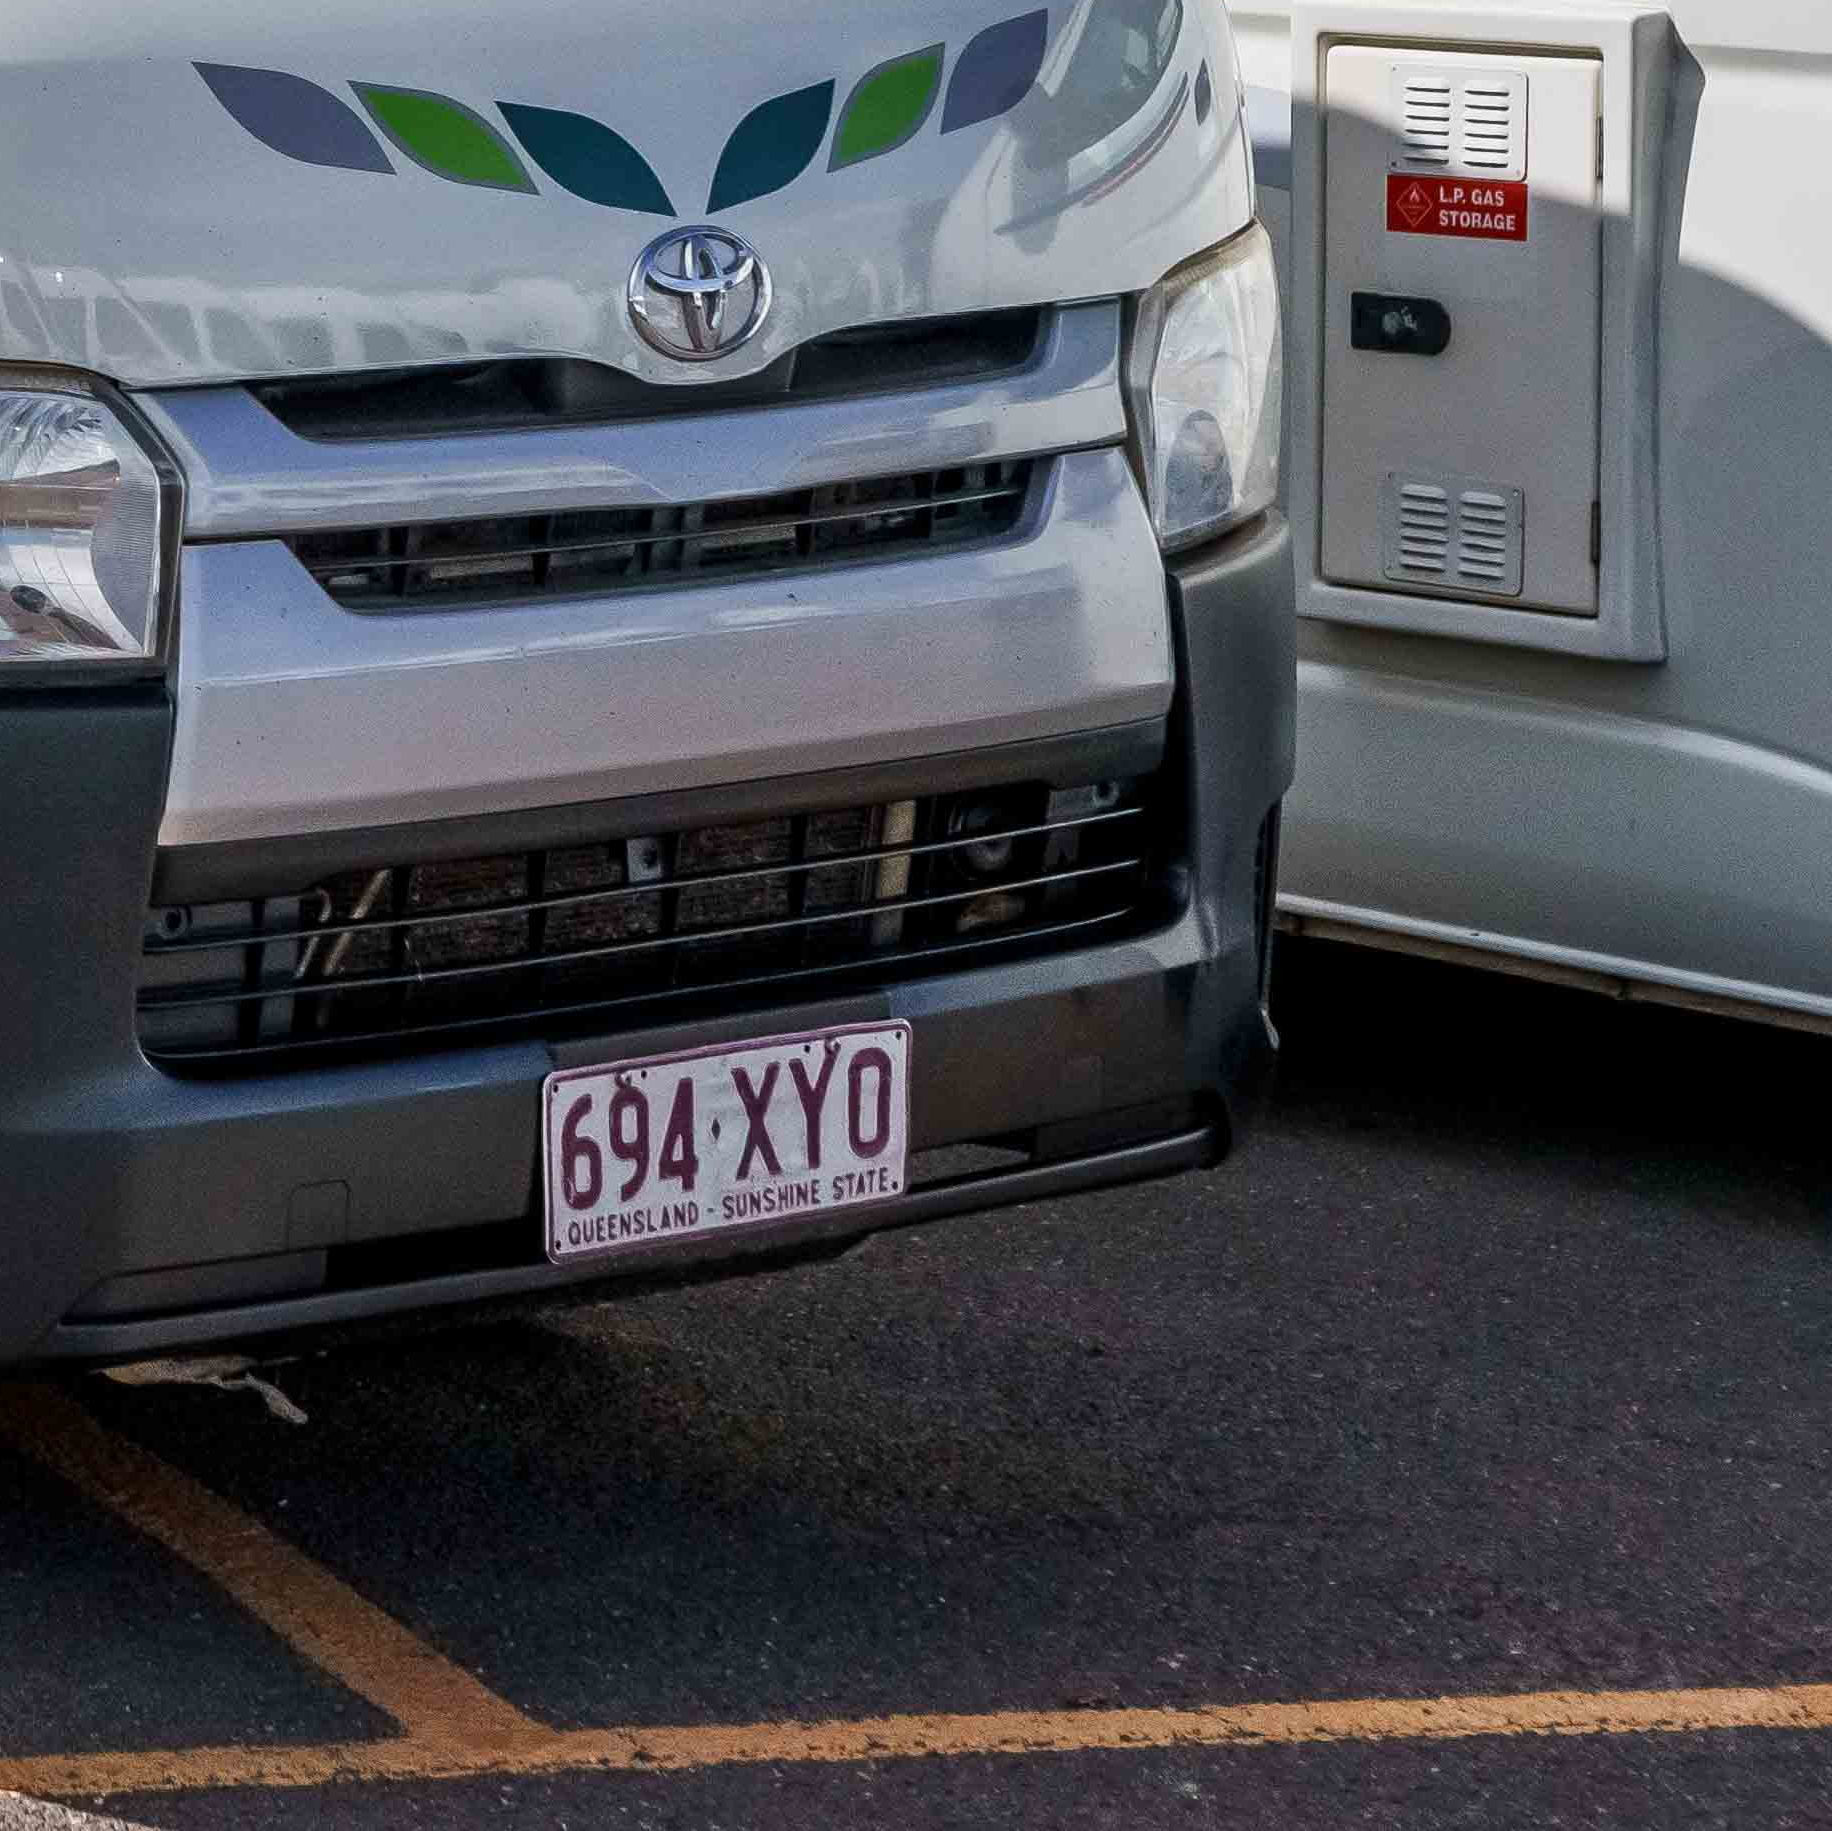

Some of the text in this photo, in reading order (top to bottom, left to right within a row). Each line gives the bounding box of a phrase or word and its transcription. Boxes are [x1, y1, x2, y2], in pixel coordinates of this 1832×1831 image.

[1439, 185, 1505, 207] L.P. GAS
[1439, 210, 1516, 231] STORAGE
[561, 1044, 893, 1211] 694 XYO
[568, 1201, 699, 1246] QUEENSLAND
[722, 1180, 821, 1220] SUNSHINE
[832, 1167, 889, 1200] STATE
